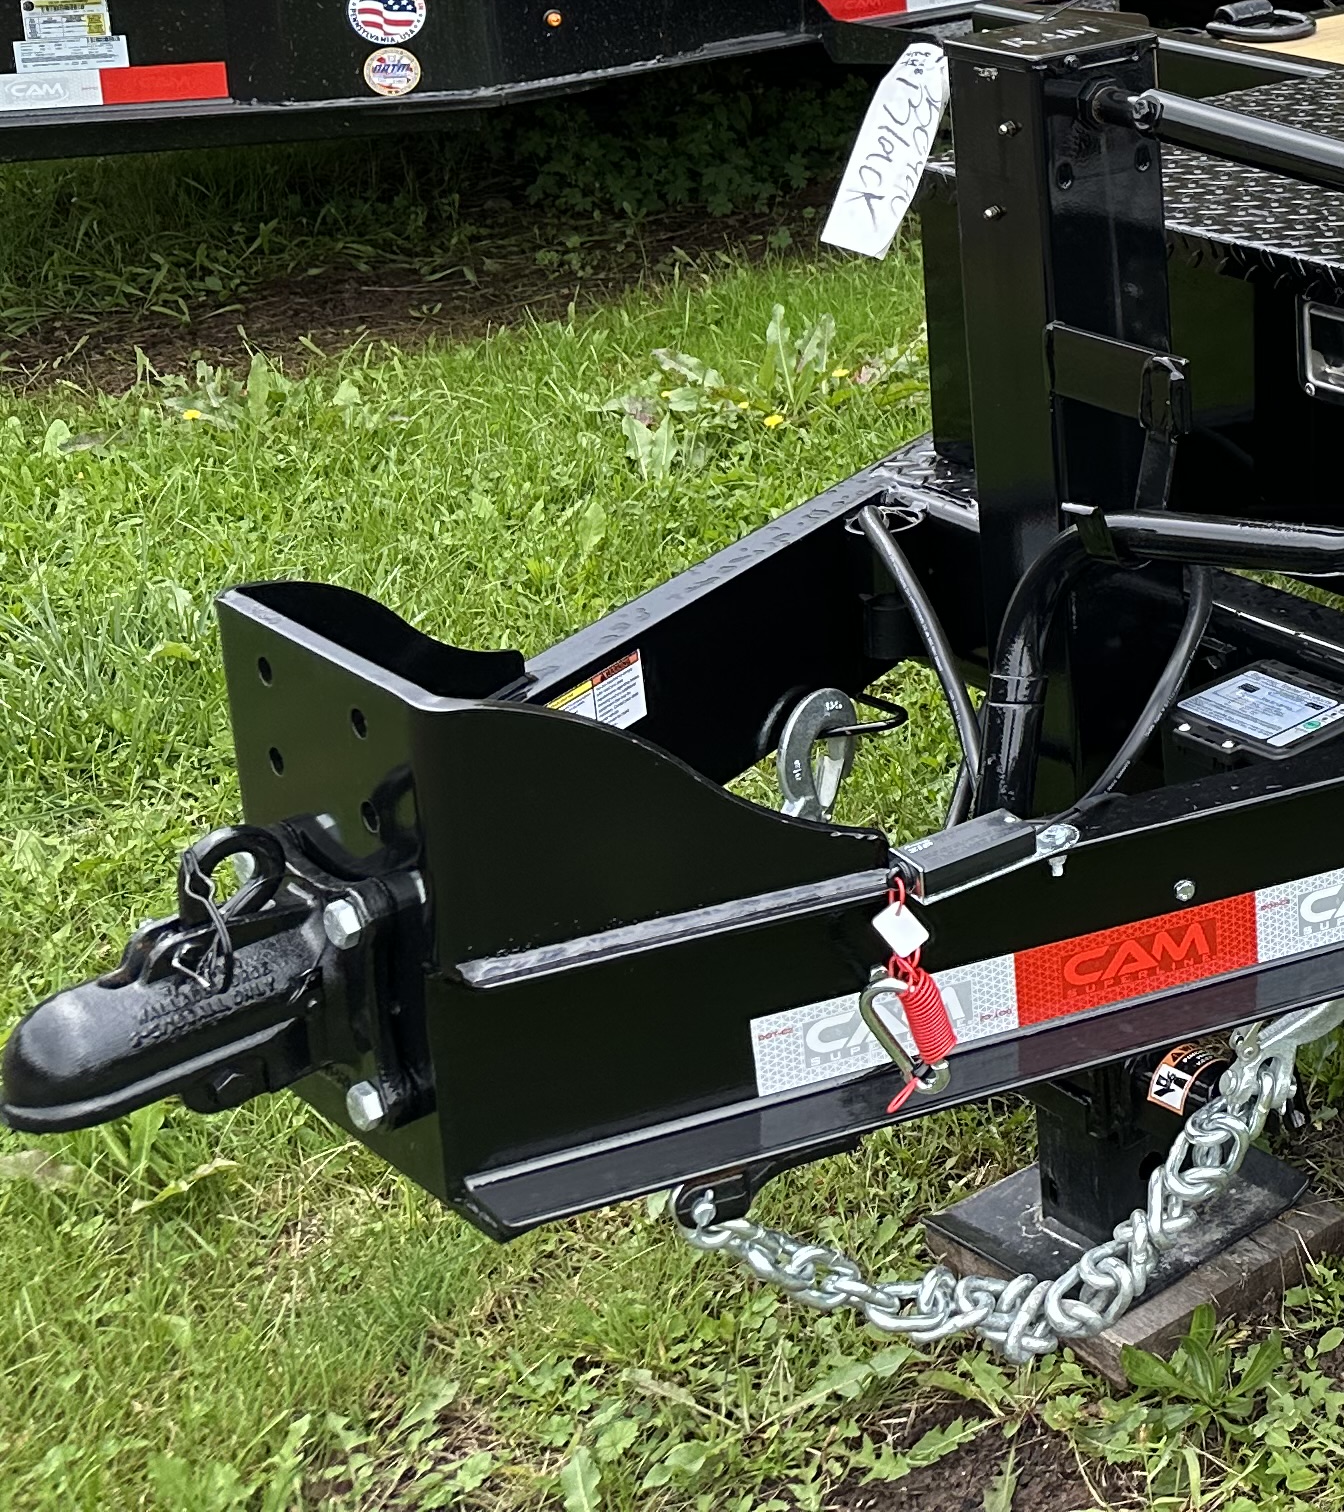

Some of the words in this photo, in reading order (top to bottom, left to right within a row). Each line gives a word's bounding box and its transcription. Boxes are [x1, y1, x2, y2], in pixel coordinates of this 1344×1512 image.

[11, 81, 65, 97] CAM
[1063, 922, 1210, 986] CAM
[1067, 952, 1212, 998] SUPERLINE
